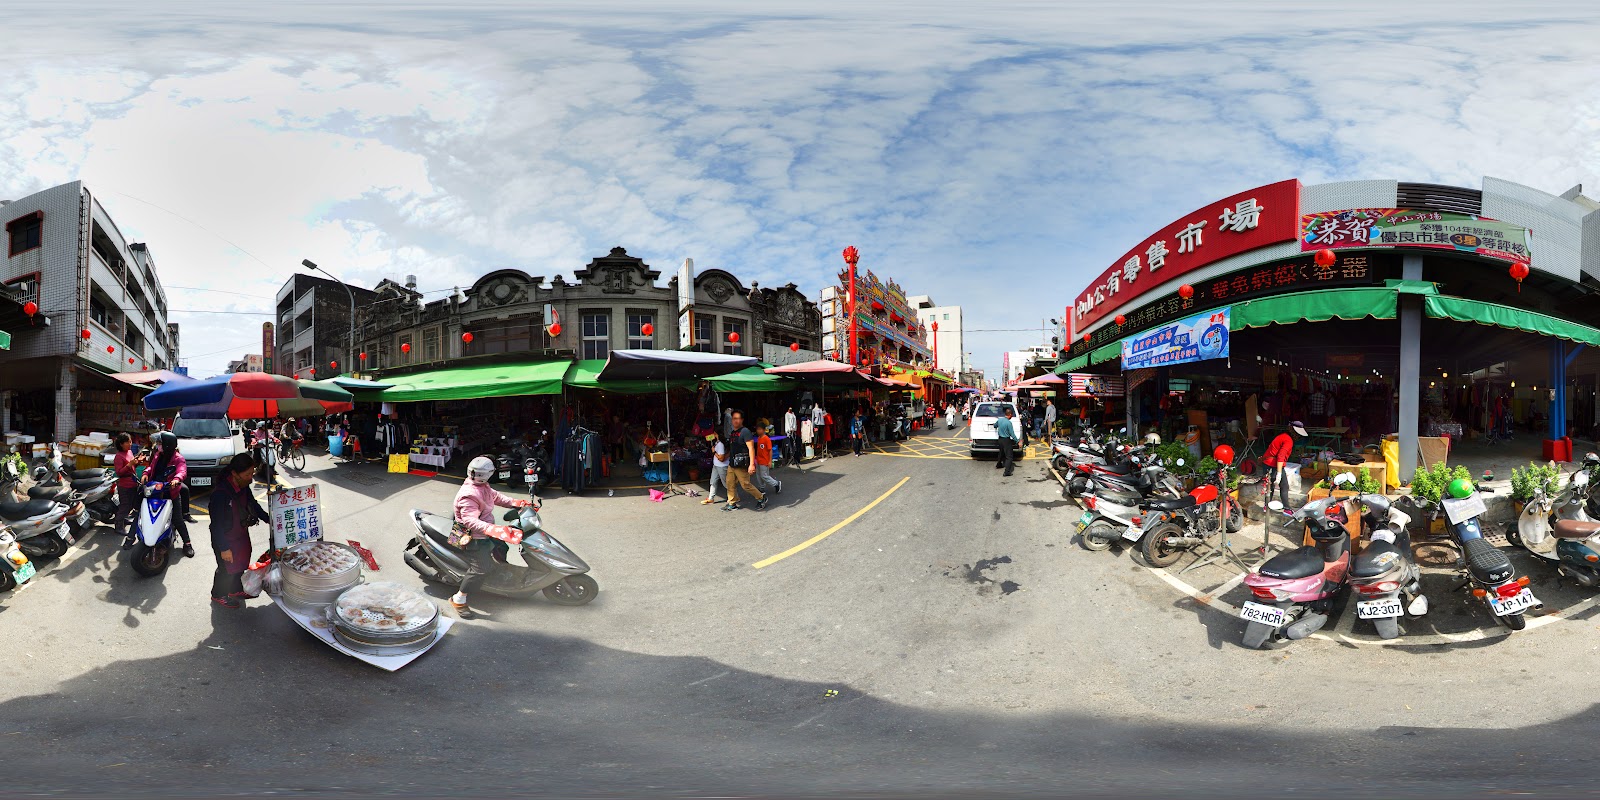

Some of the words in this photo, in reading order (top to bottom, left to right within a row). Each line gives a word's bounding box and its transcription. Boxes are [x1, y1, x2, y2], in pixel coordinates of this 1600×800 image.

[1386, 212, 1442, 226] 中山市場
[1311, 218, 1375, 245] 恭賀
[1076, 198, 1263, 320] 中山公有零售市場
[277, 483, 317, 505] 奮起湖
[283, 509, 297, 545] 草仔粿
[1358, 604, 1400, 616] KJ2-307
[1493, 593, 1533, 614] LXP-147
[1242, 606, 1281, 625] 782-HCR
